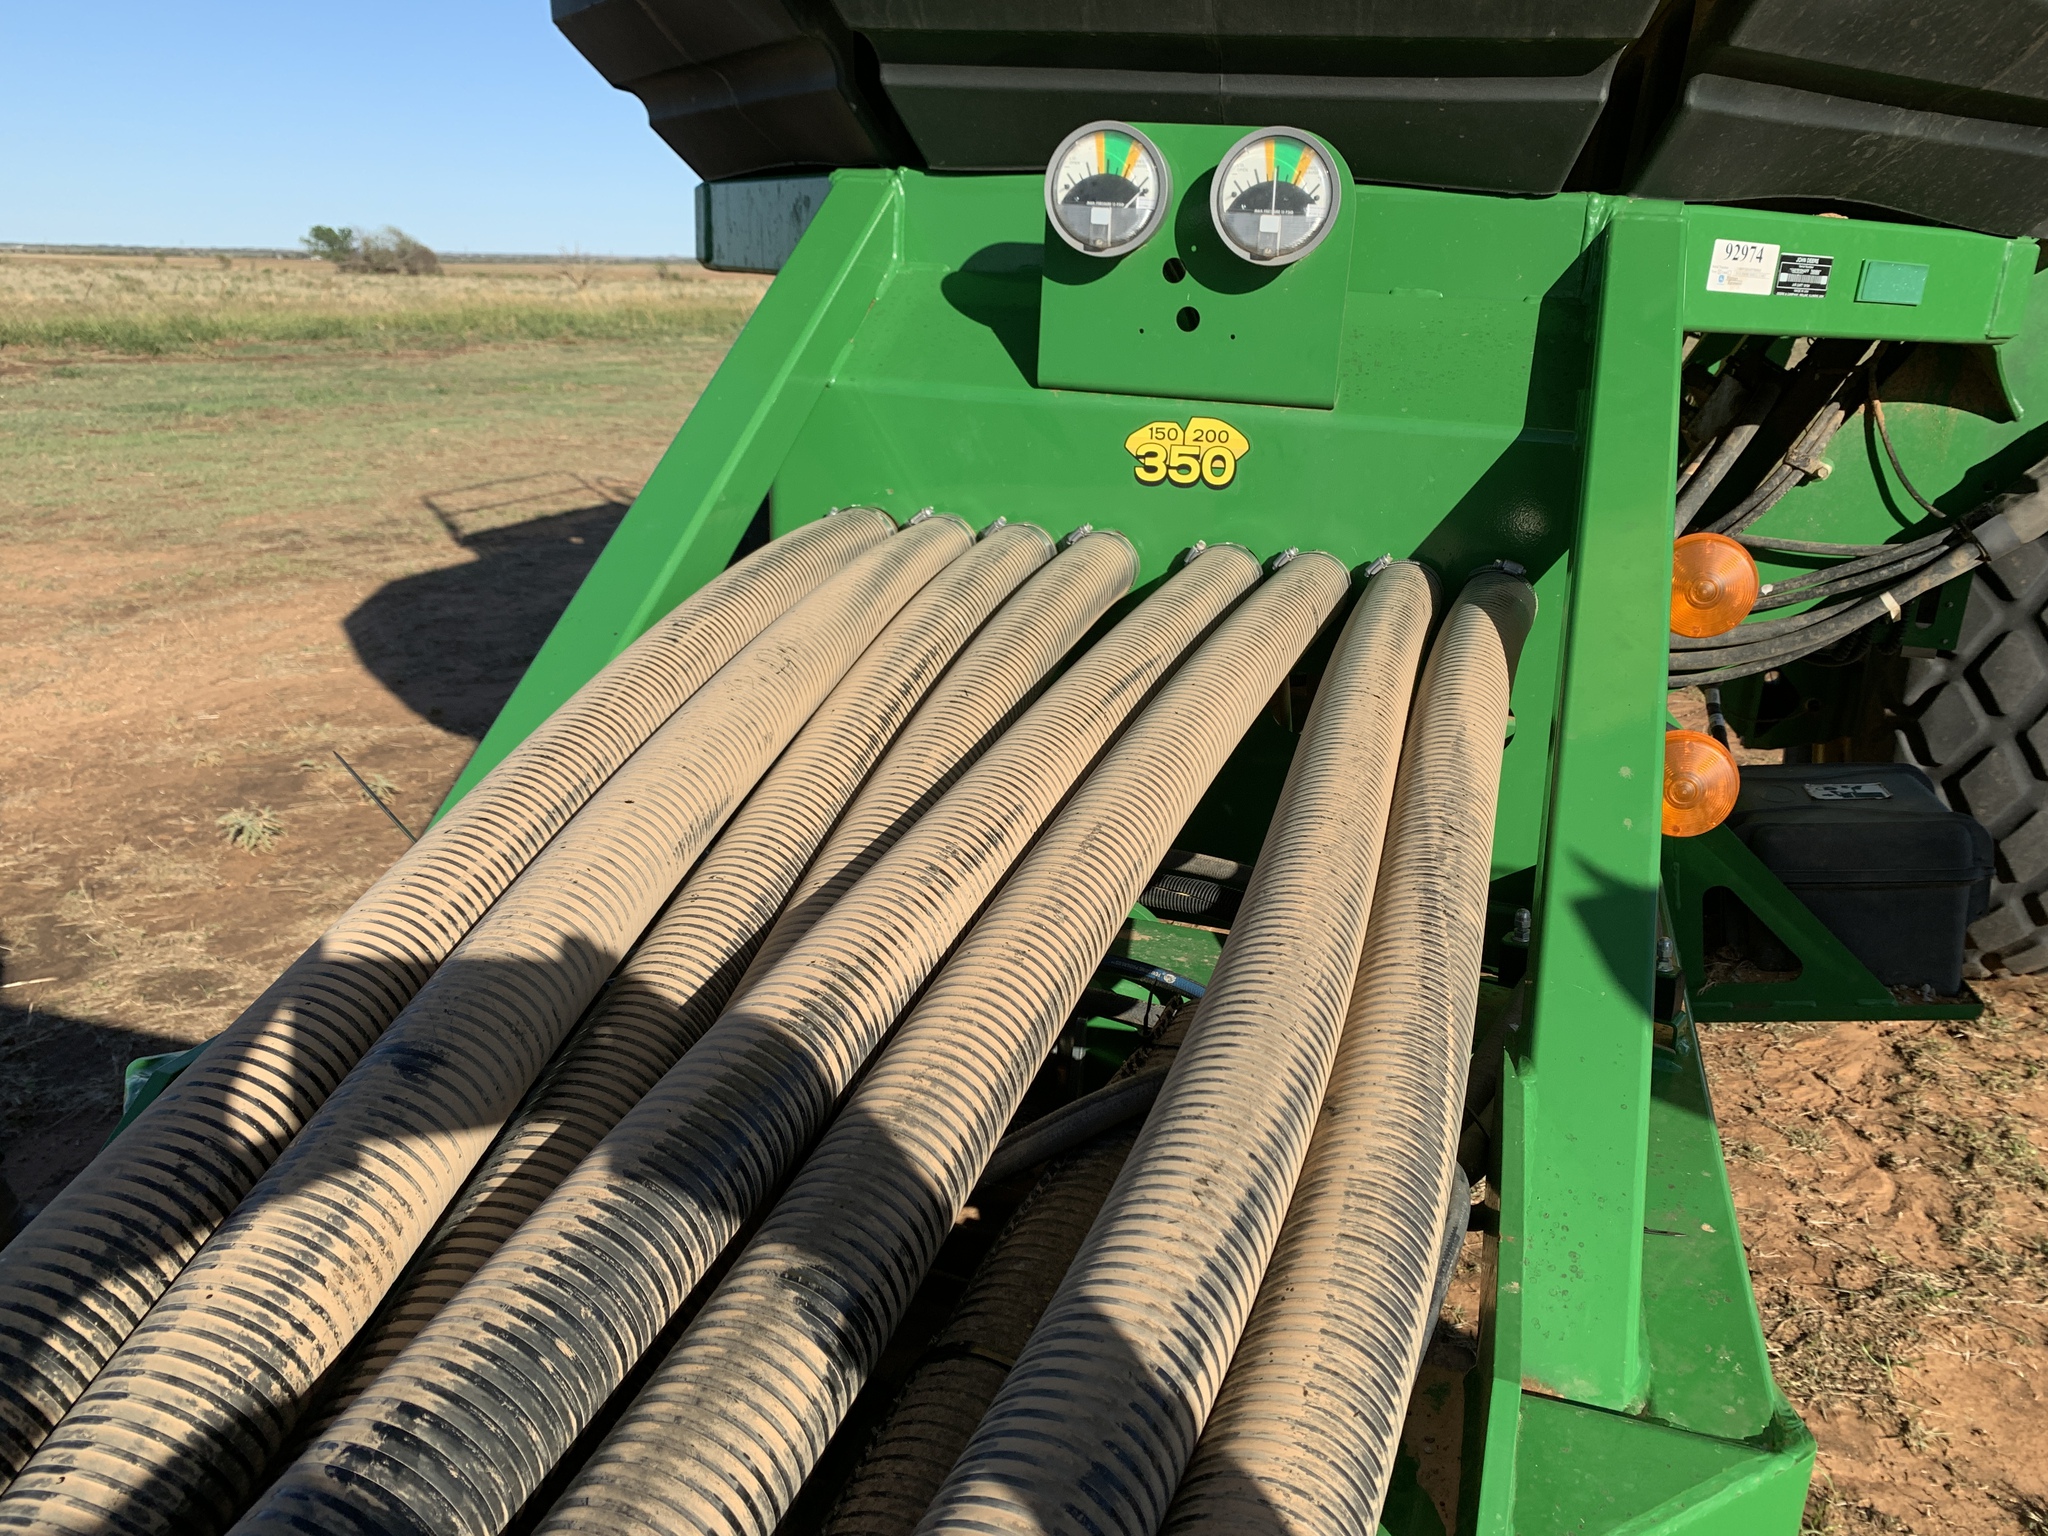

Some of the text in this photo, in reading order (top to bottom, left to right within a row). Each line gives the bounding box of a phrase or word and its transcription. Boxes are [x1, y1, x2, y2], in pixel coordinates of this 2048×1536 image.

[1724, 242, 1765, 264] 92974
[1148, 426, 1230, 444] 150 200
[1134, 442, 1237, 490] 350
